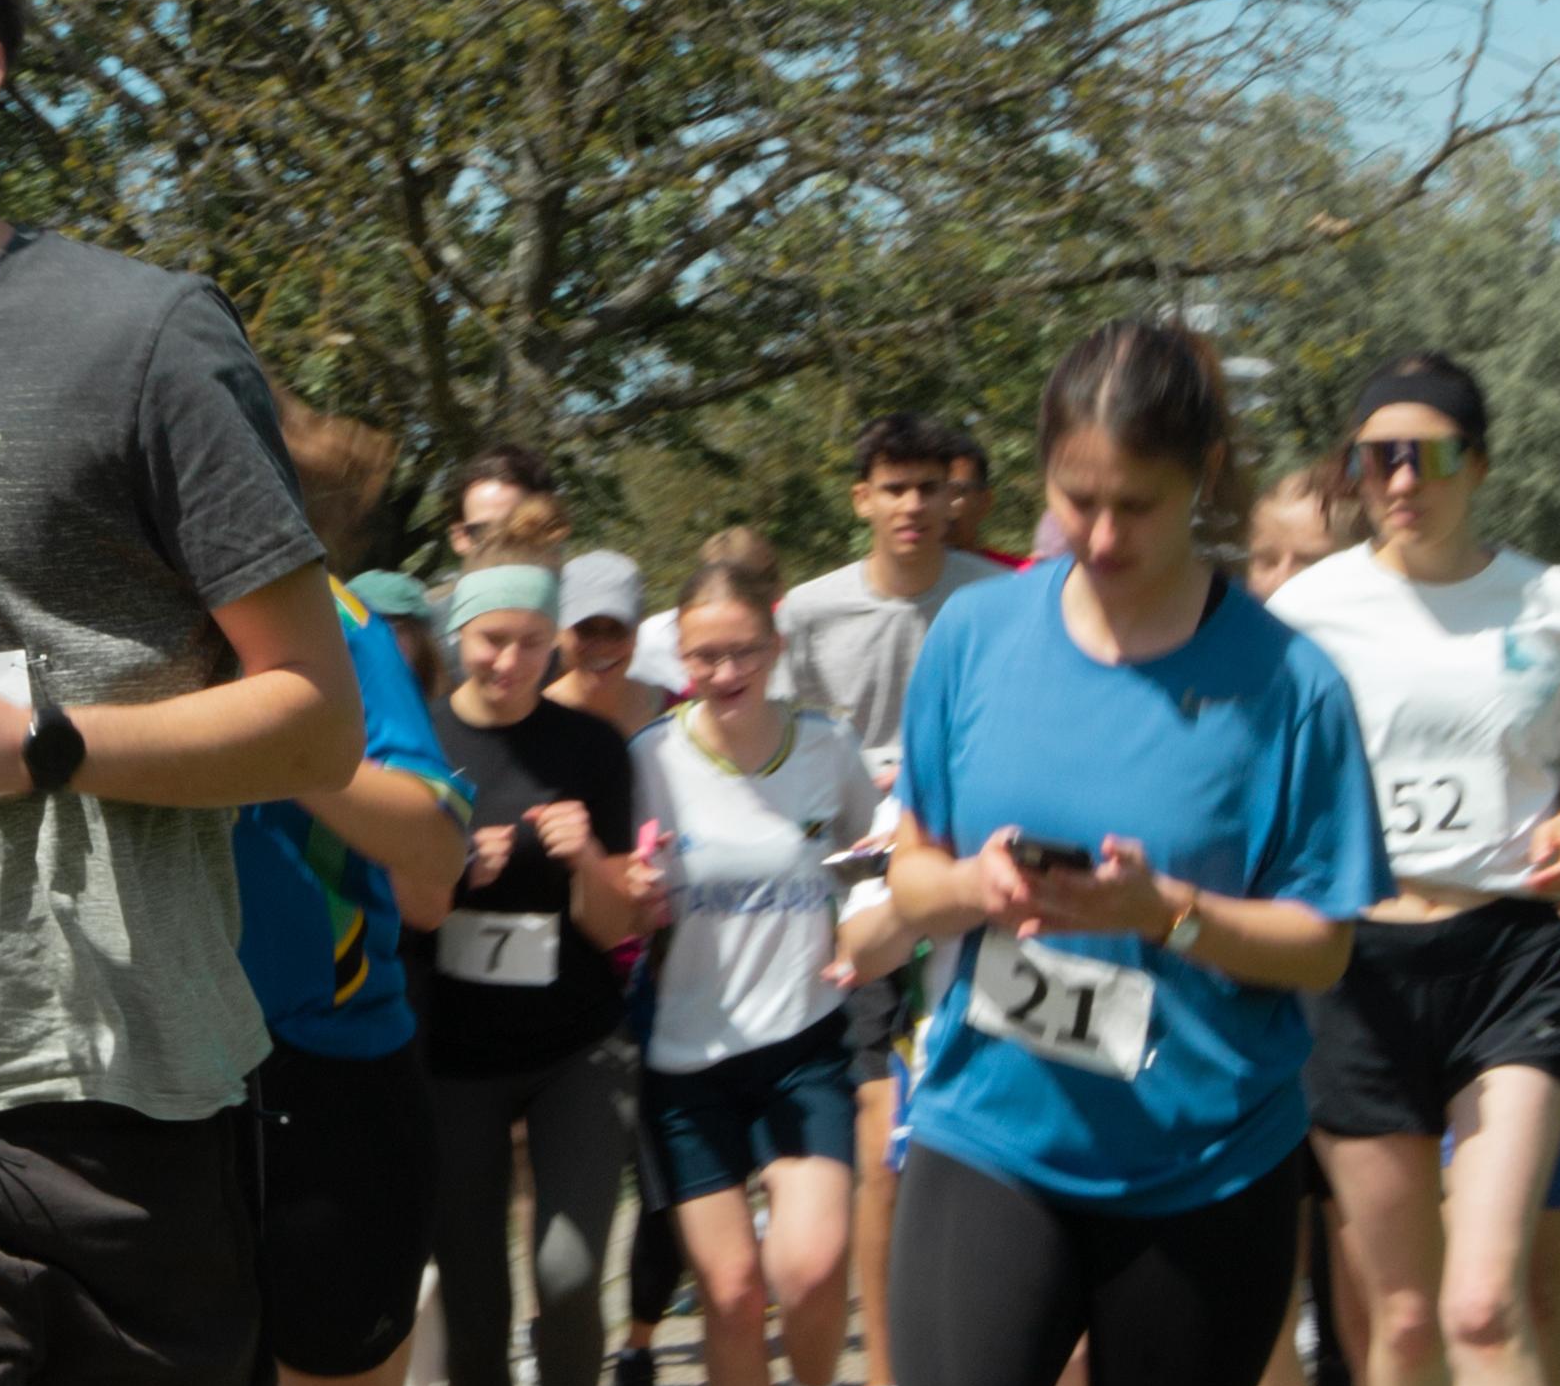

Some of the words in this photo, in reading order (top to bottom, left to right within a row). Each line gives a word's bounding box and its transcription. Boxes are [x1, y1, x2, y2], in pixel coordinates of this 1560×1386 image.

[1383, 777, 1472, 835] 52
[480, 926, 514, 974] 7
[1005, 960, 1099, 1049] 21
